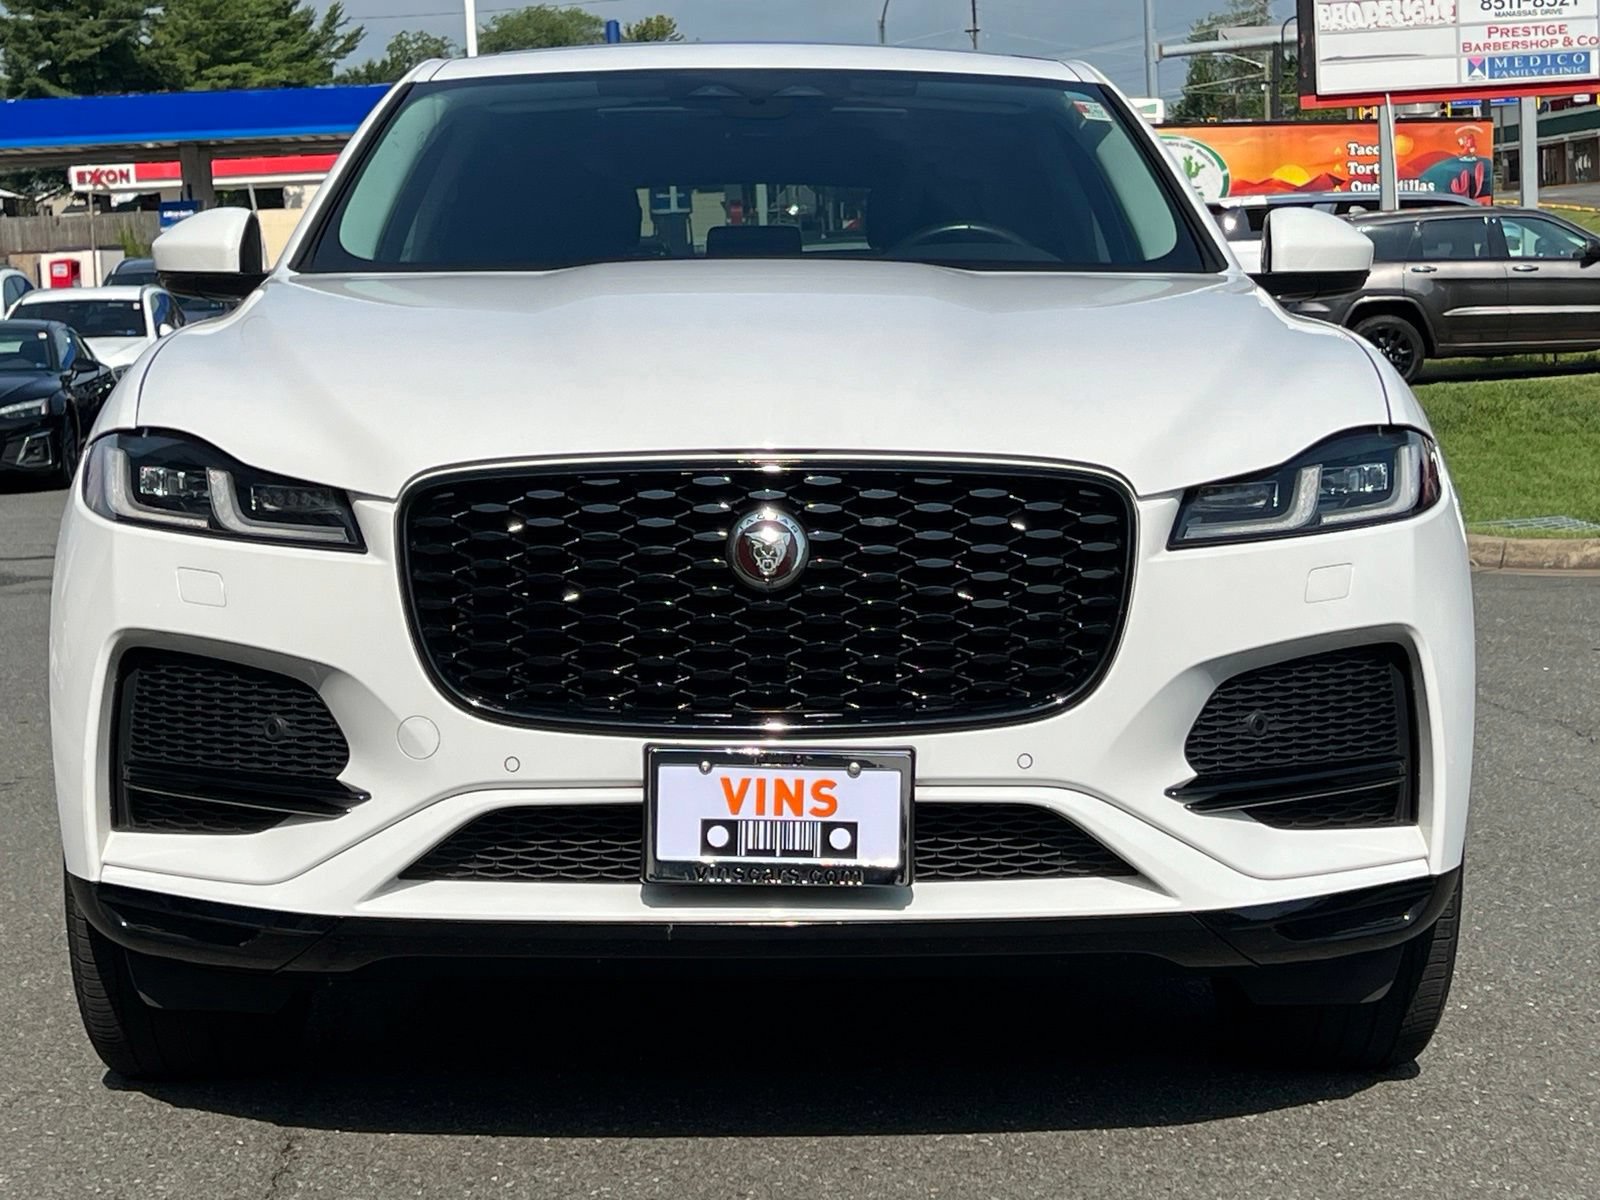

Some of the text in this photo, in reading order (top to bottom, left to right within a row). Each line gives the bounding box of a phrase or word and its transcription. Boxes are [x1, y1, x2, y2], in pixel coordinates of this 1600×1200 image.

[1494, 8, 1563, 18] MANASSAS DRIVE
[1487, 24, 1568, 39] PRESTIGE
[1462, 39, 1559, 53] BARBERSHOP
[1562, 36, 1574, 48] &
[1494, 52, 1586, 69] MEDICO
[1494, 68, 1540, 79] FAMILY
[1542, 65, 1585, 76] CLINIC
[76, 168, 131, 185] EXXON
[720, 777, 838, 818] VINS
[693, 864, 865, 886] vinscars.com
